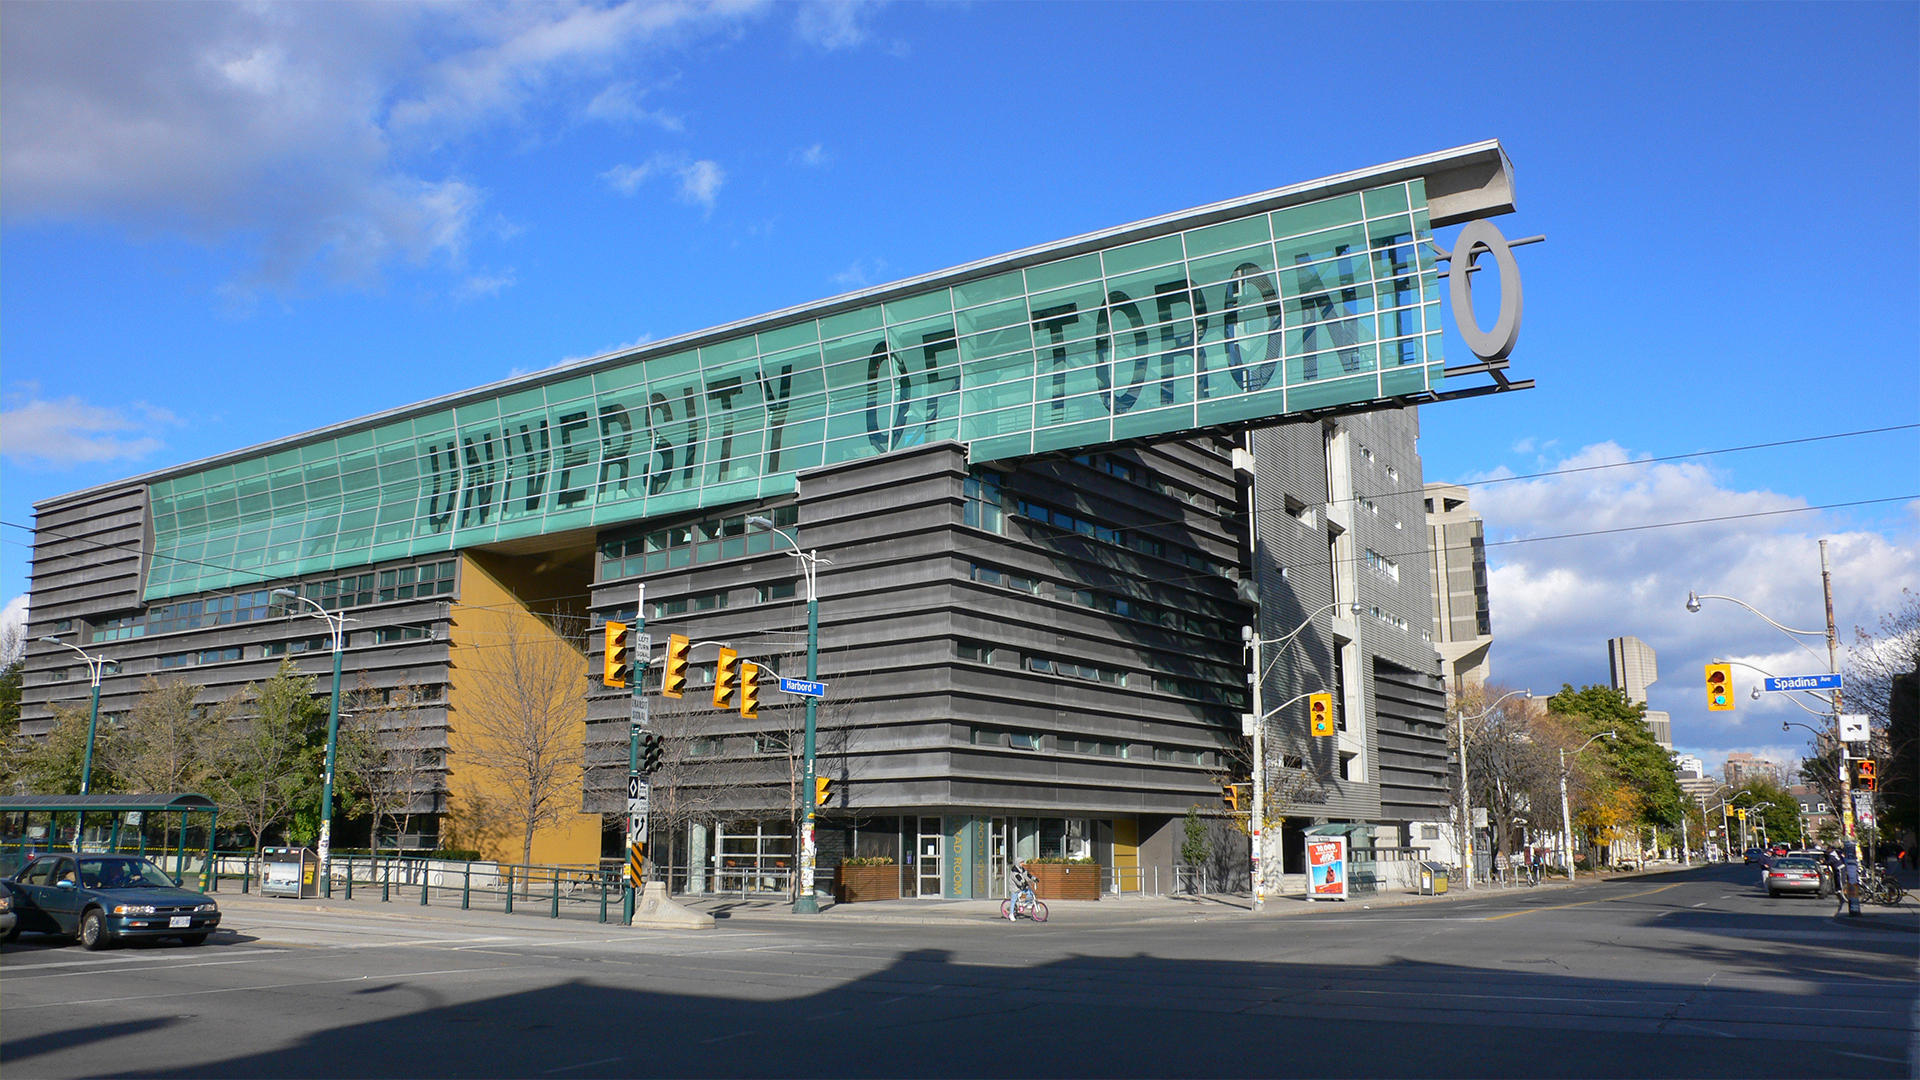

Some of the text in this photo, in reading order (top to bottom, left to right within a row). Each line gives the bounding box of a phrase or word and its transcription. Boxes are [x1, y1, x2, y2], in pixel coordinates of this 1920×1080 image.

[428, 218, 1523, 534] UNIVERSITY OF TORONTO
[786, 680, 812, 692] Harbord
[1774, 677, 1818, 690] Spadina
[977, 819, 985, 856] ROOM
[953, 820, 963, 895] RAD ROOM
